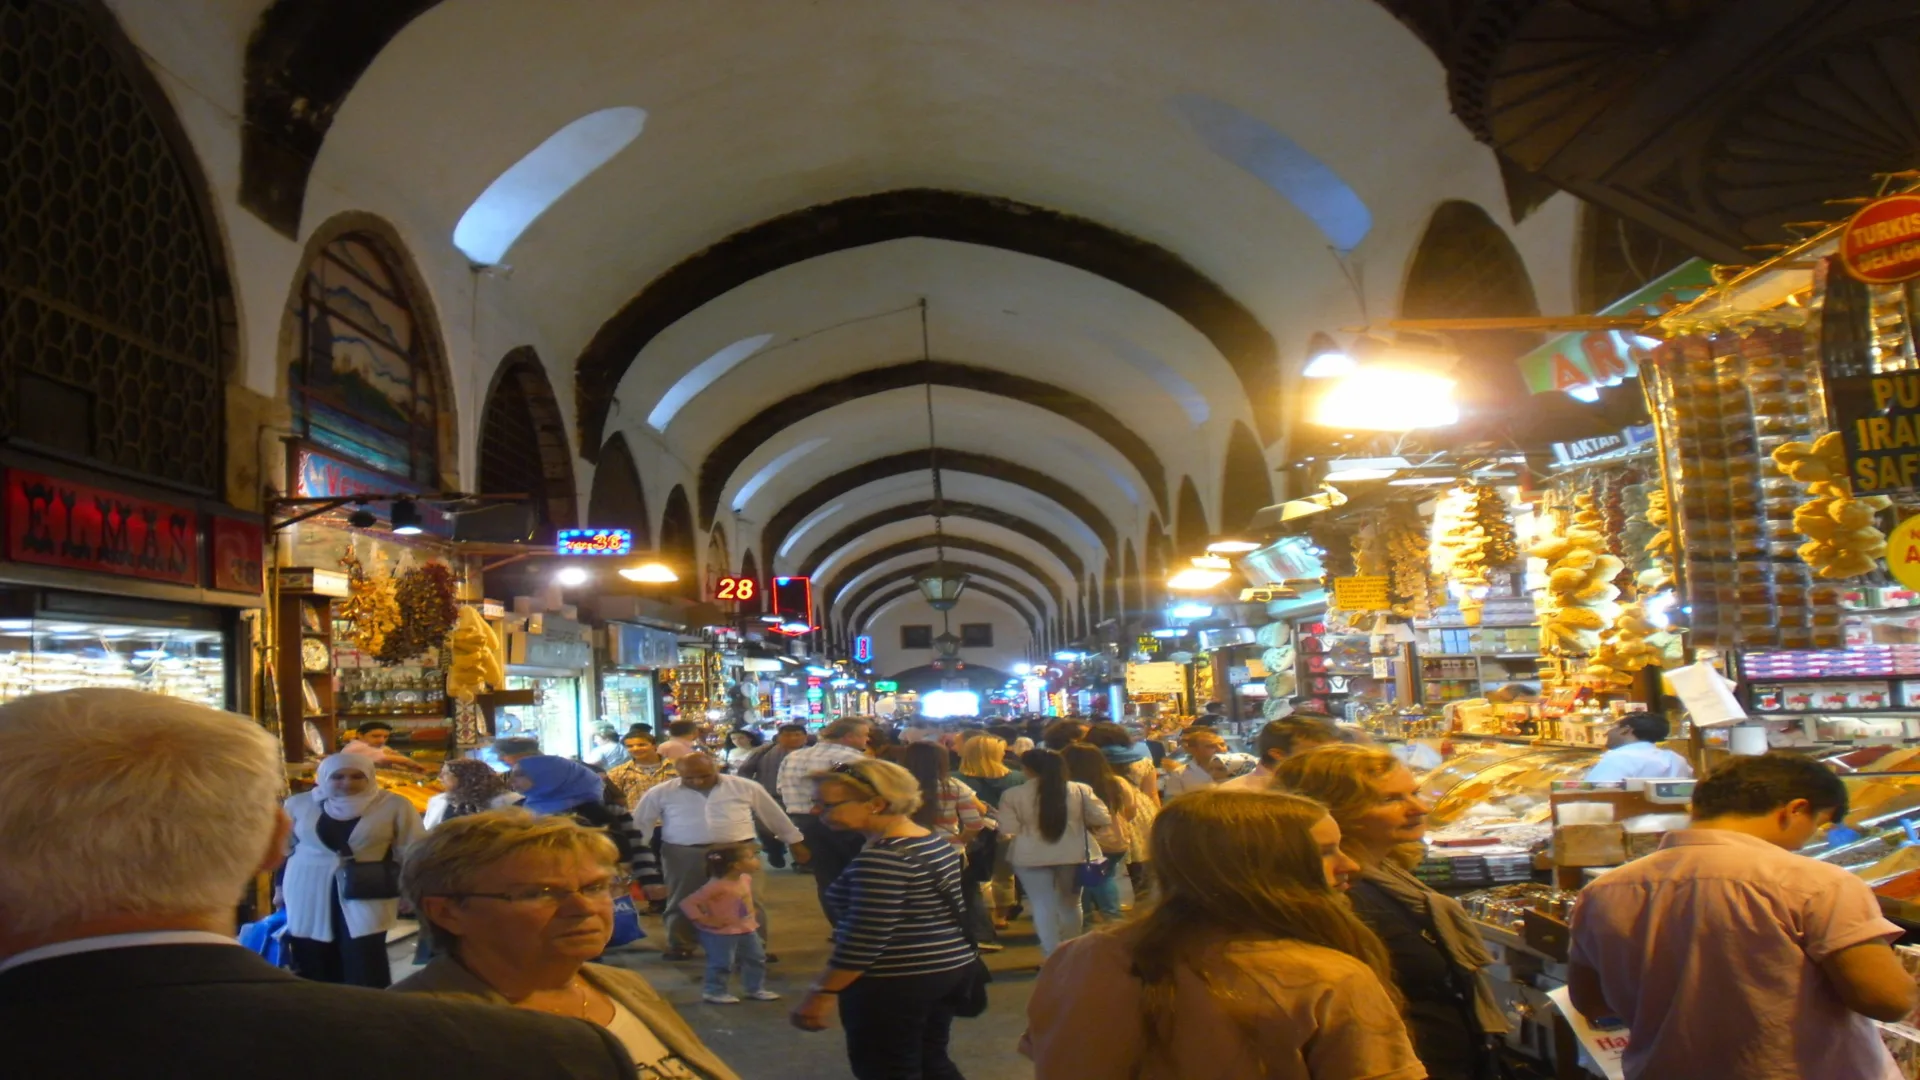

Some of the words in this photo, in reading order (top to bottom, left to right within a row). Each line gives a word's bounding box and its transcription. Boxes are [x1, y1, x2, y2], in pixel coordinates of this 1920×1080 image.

[1872, 374, 1920, 409] PU
[1856, 453, 1920, 491] SAF
[22, 480, 187, 574] ELMAS
[593, 534, 622, 550] 38
[717, 578, 754, 600] 28
[1594, 1036, 1629, 1051] Ha
